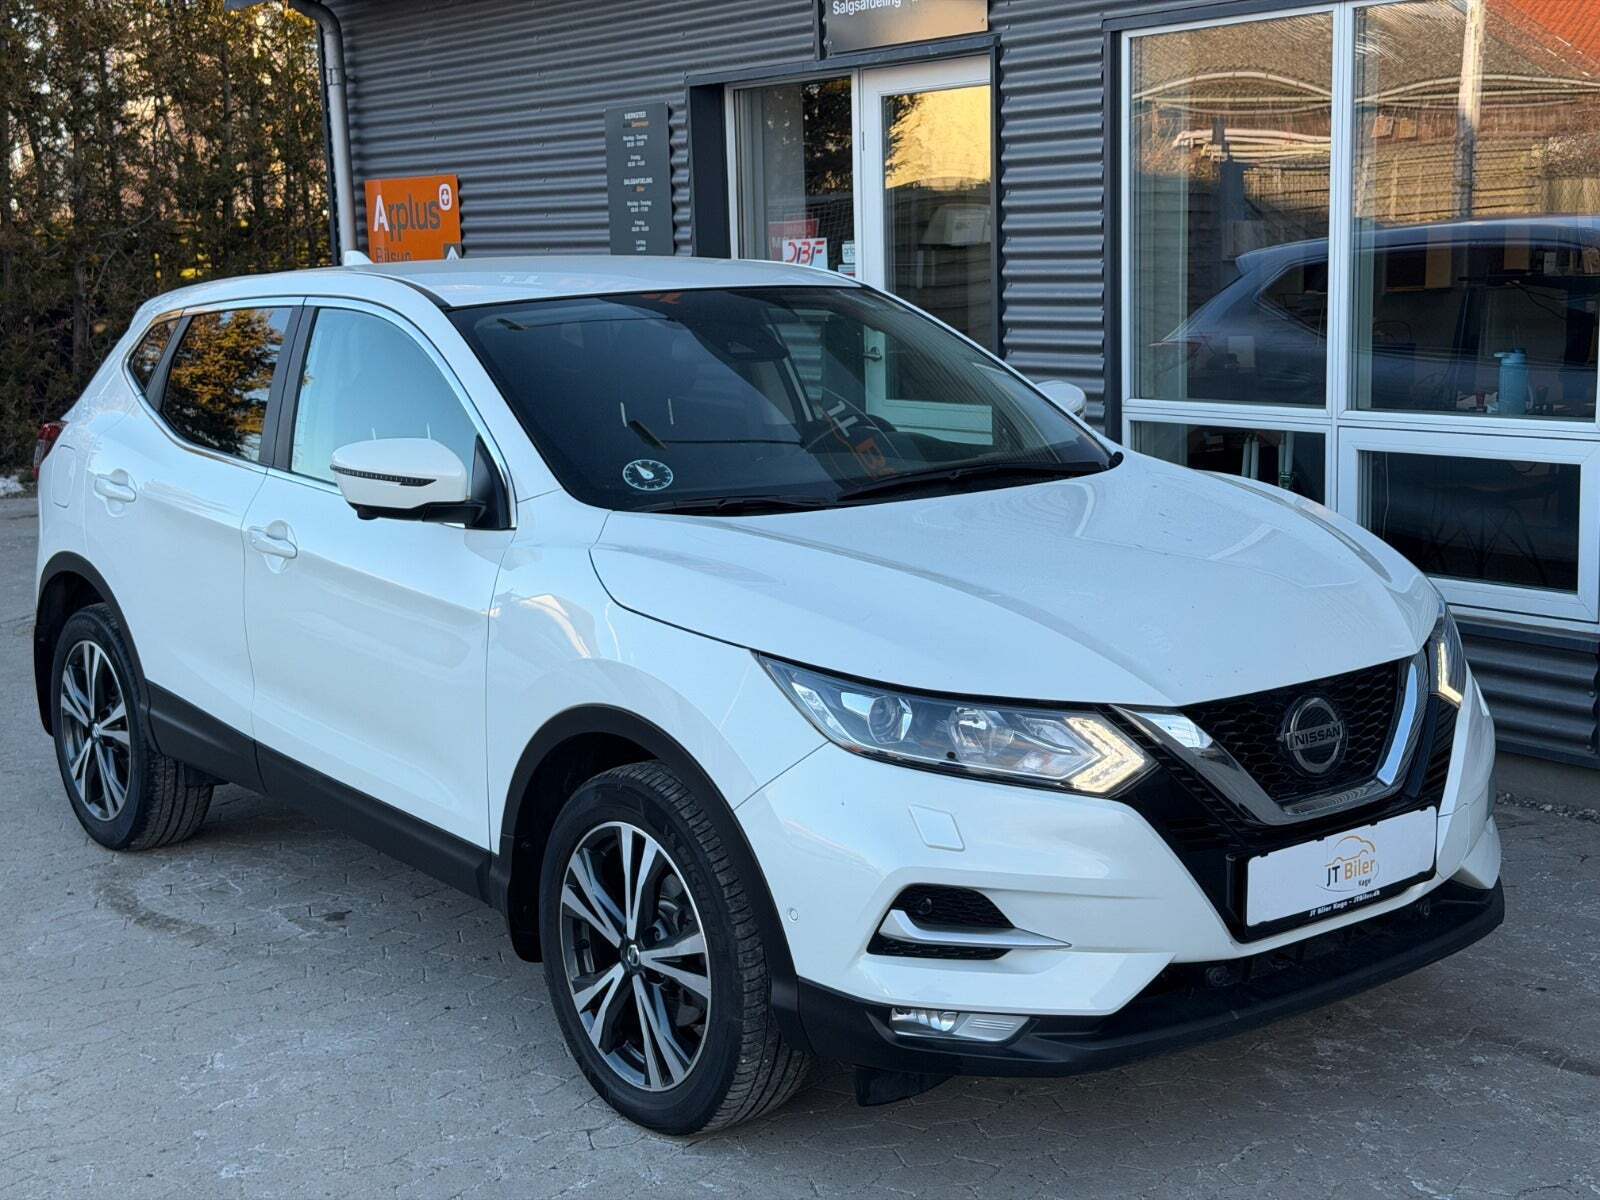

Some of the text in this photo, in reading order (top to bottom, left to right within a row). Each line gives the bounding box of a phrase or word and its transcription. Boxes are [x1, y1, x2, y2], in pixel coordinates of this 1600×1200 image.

[1295, 724, 1341, 746] NISSAN
[1326, 859, 1376, 887] JT Biler
